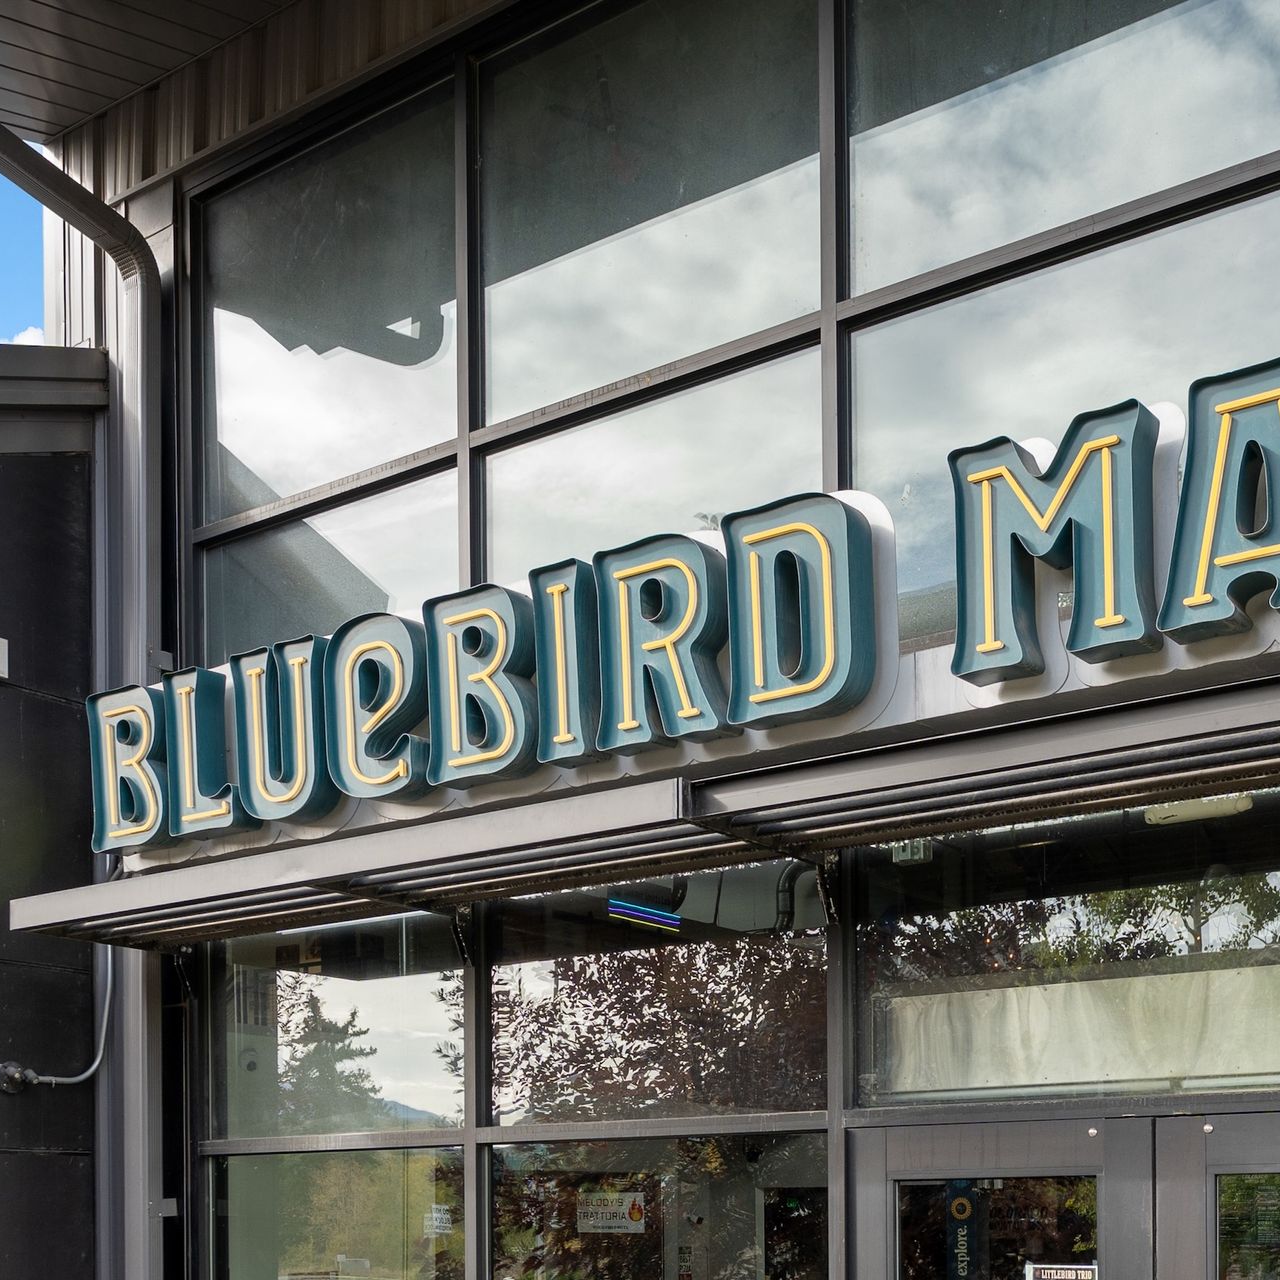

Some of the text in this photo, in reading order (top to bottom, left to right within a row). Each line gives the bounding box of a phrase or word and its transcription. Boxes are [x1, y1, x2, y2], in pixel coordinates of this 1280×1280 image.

[954, 1224, 969, 1277] explore.
[1041, 1269, 1093, 1280] LITTLEBIRD TRIO
